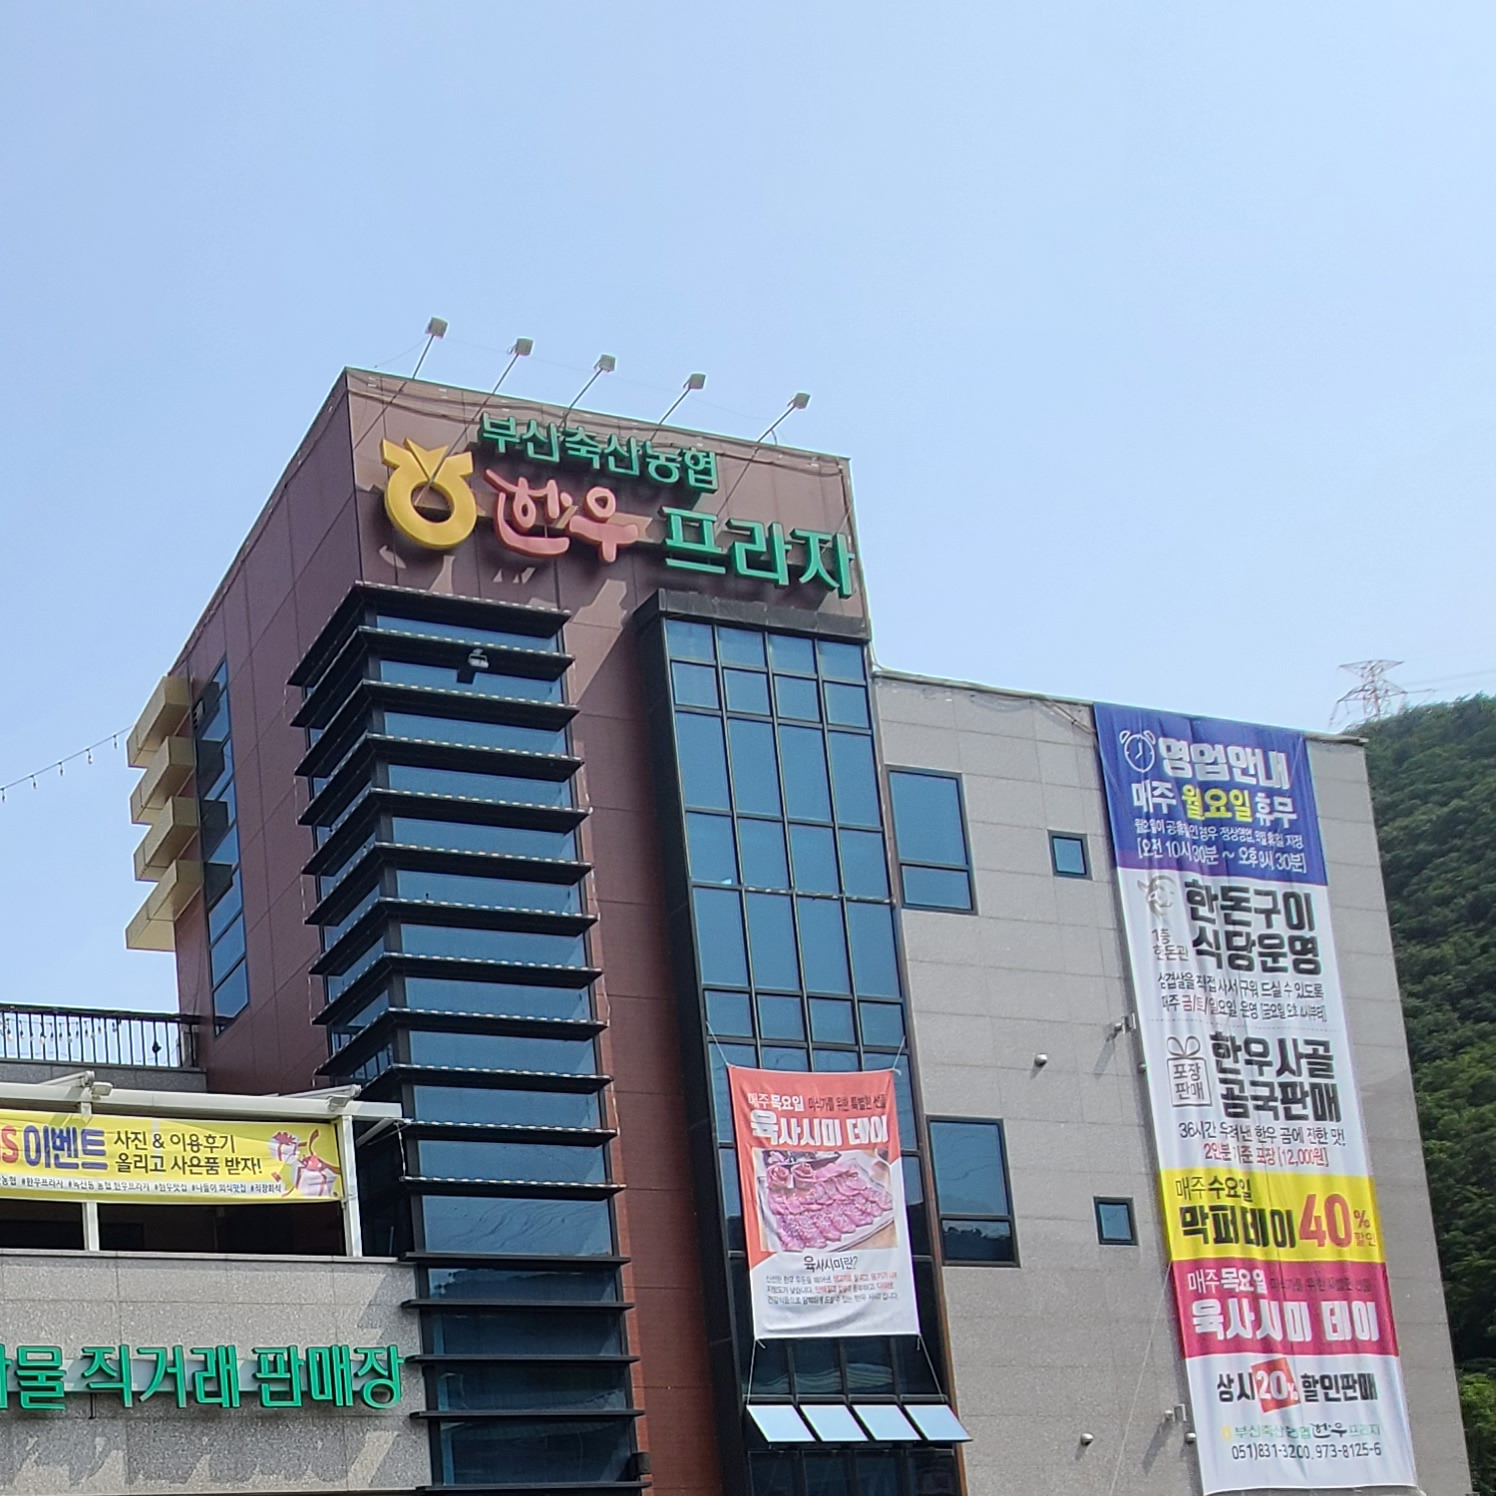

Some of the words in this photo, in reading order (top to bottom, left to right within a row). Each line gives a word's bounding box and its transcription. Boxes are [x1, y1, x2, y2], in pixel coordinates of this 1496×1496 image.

[480, 411, 720, 493] 부산축산농협
[1158, 737, 1291, 790] 영업안내
[1131, 779, 1177, 815] 매주
[1181, 783, 1253, 823] 월요일
[1255, 792, 1297, 828] 휴무
[1184, 878, 1316, 932] 한돈구이
[1192, 926, 1322, 976] 식당운영
[1173, 1062, 1201, 1082] 포장
[1209, 1031, 1335, 1080] 한우사골
[771, 1093, 805, 1111] 목요일
[1175, 1081, 1204, 1101] 판매
[1218, 1077, 1341, 1123] 곰국판매
[114, 1130, 148, 1150] 사진
[153, 1133, 165, 1149] &
[170, 1133, 236, 1154] 이용후기
[750, 1109, 843, 1146] 육사시미
[846, 1115, 889, 1145] 데이
[1178, 1120, 1216, 1139] 36시간
[1255, 1125, 1277, 1145] 한우
[1307, 1127, 1329, 1146] 진한
[23, 1124, 108, 1171] 이벤트
[115, 1152, 167, 1173] 올리고
[171, 1157, 221, 1175] 사은품
[224, 1157, 263, 1175] 받자!
[1204, 1142, 1232, 1162] 2인분
[1175, 1176, 1206, 1201] 매주
[1207, 1175, 1253, 1203] 수요일
[1179, 1204, 1296, 1249] 막퍼데이
[804, 1255, 858, 1272] 육사시미란?
[1187, 1268, 1219, 1295] 매주
[1221, 1267, 1268, 1295] 목요일
[1191, 1297, 1312, 1342] 육사시미
[1320, 1300, 1379, 1342] 데이
[81, 1343, 243, 1409] 직거래
[252, 1343, 404, 1410] 판매장
[1216, 1372, 1255, 1402] 상시
[1300, 1372, 1378, 1402] 할인판매
